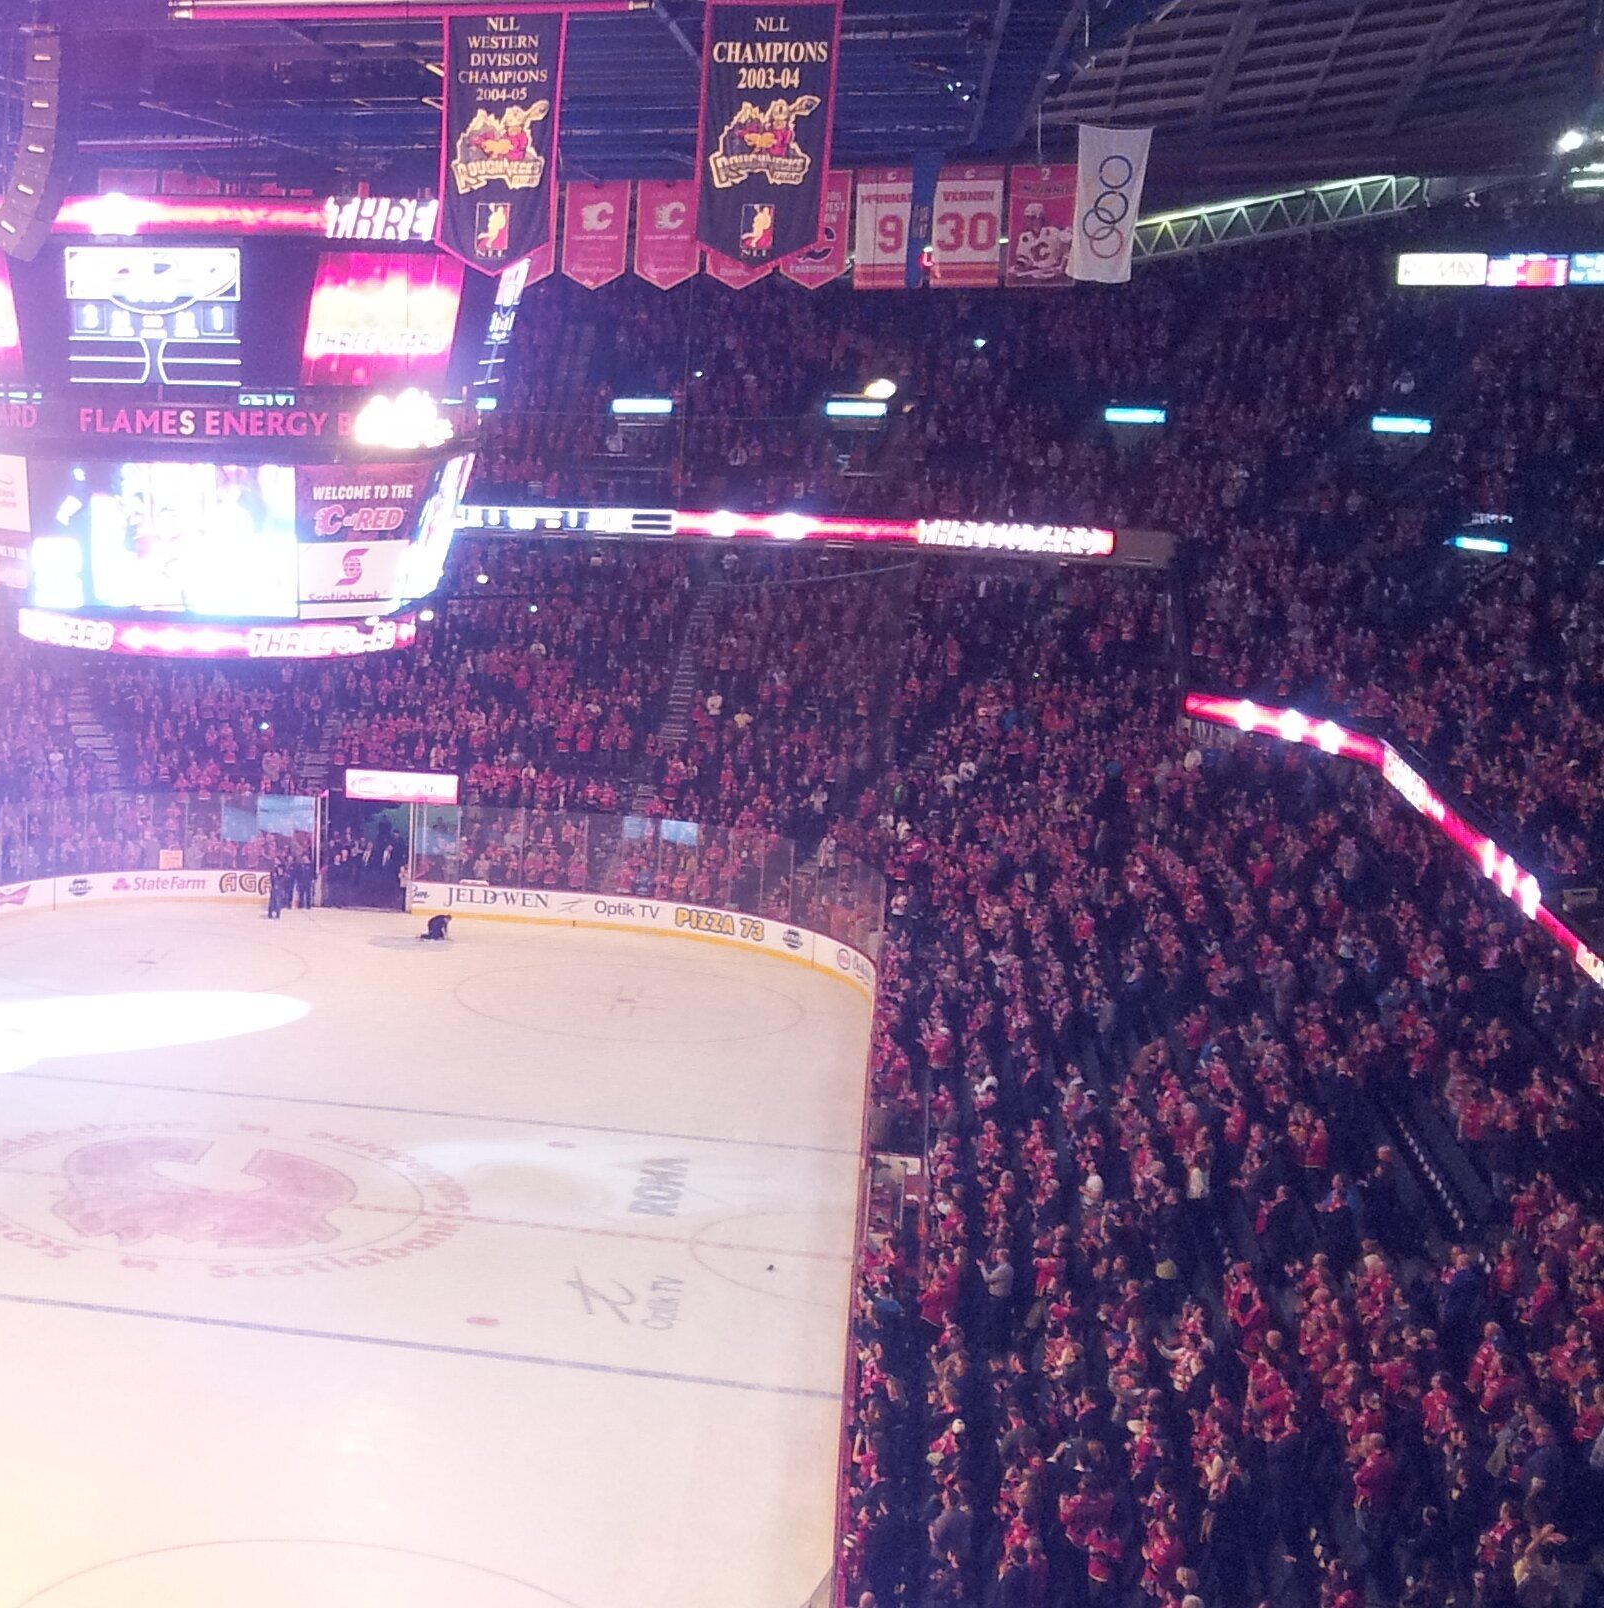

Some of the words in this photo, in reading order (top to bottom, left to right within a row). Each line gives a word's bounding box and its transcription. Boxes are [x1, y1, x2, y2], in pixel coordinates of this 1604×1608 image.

[486, 16, 520, 31] NLL
[755, 17, 790, 32] NLL
[467, 35, 539, 49] WESTERN
[470, 53, 538, 67] DIVISION
[712, 41, 828, 63] CHAMPIONS
[458, 69, 548, 84] CHAMPIONS
[737, 68, 800, 89] 2003-04
[476, 87, 528, 101] 2004-05
[878, 214, 904, 253] 9
[936, 212, 998, 251] 30
[79, 408, 196, 436] FLAMES
[205, 409, 328, 437] ENERGY
[312, 486, 372, 501] WELCOME
[374, 485, 389, 500] TO
[391, 484, 414, 499] THE
[353, 507, 405, 531] RED
[594, 900, 635, 917] Optik
[639, 904, 660, 919] TV
[674, 906, 735, 936] PIZZA
[740, 917, 765, 942] 73
